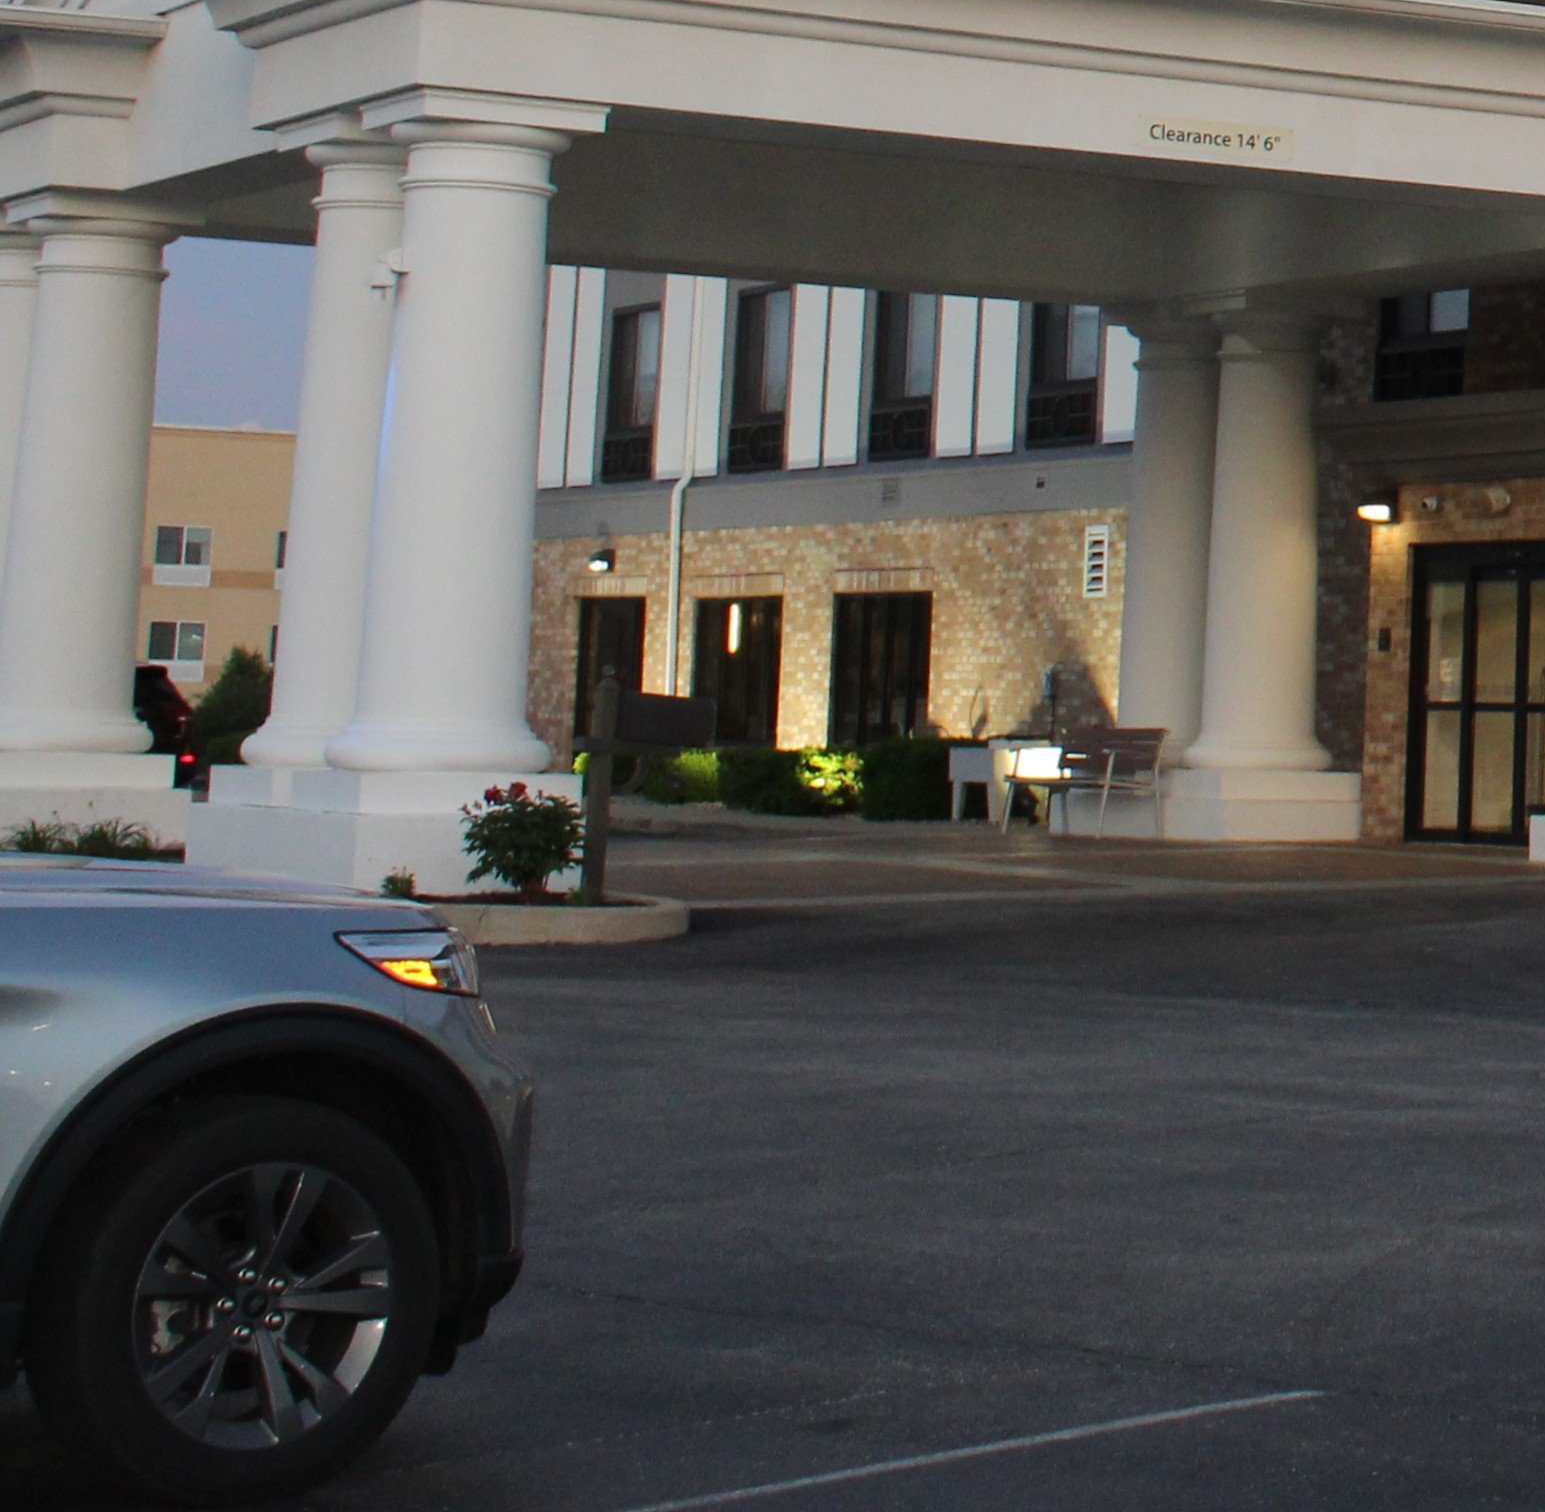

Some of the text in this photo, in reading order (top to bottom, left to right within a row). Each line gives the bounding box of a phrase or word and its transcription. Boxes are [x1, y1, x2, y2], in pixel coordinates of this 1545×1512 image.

[1149, 123, 1281, 152] Clearance 14' 6"
